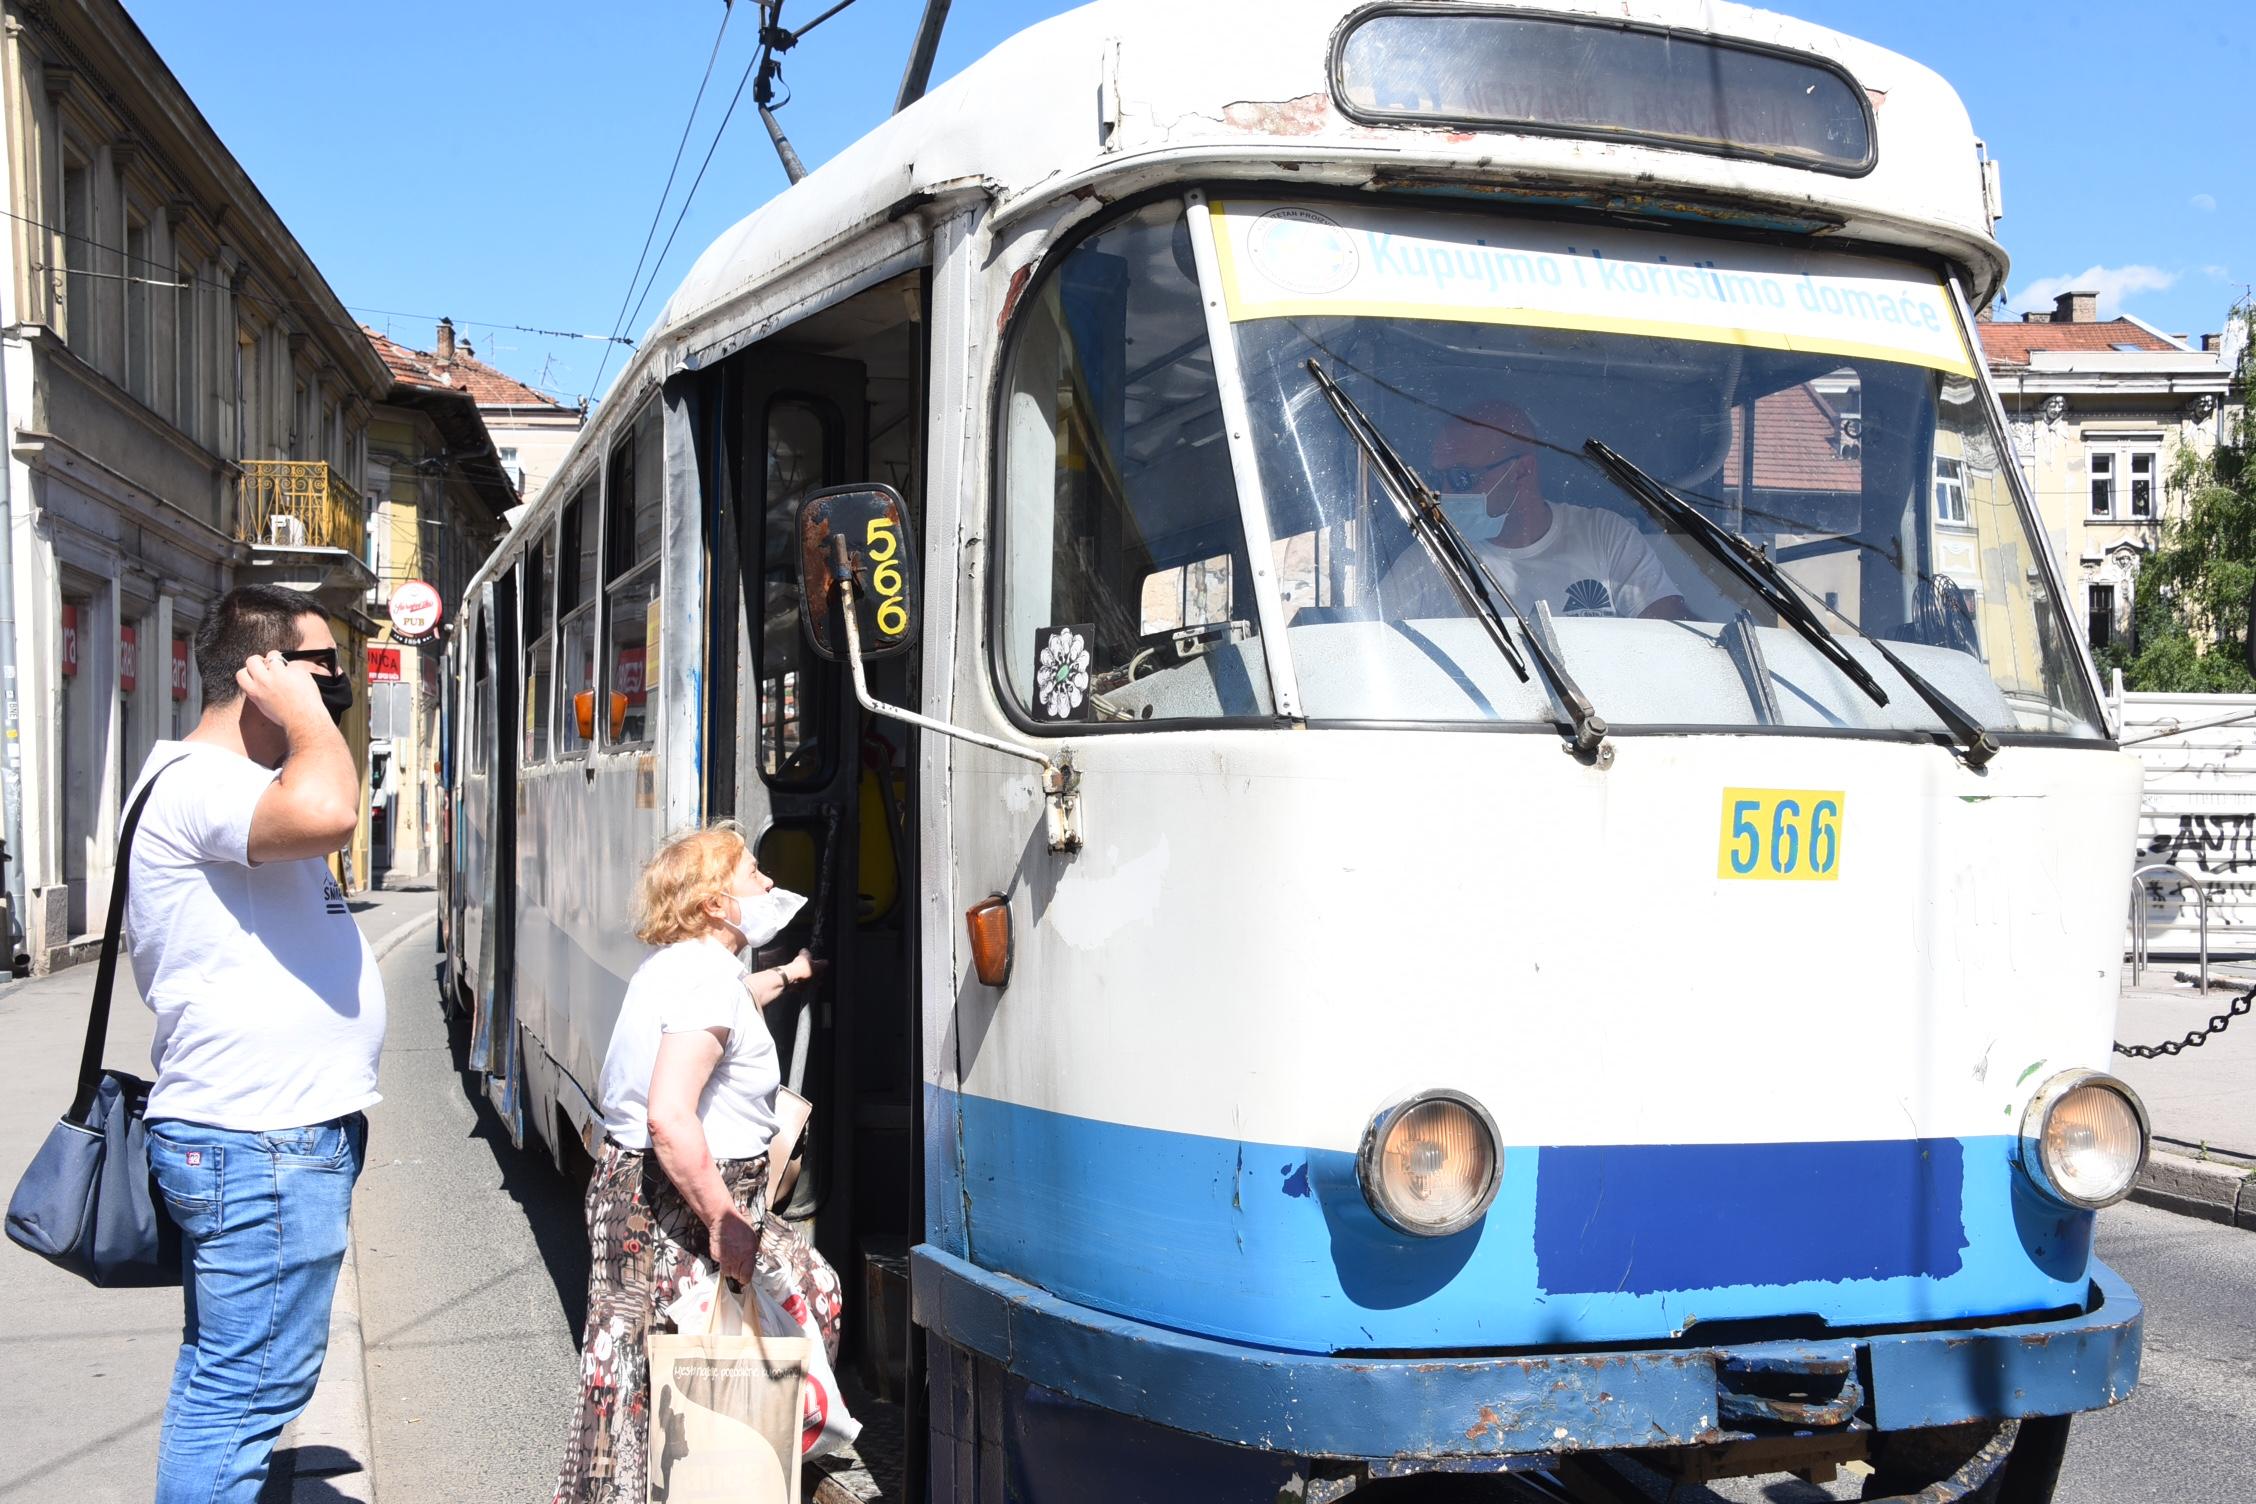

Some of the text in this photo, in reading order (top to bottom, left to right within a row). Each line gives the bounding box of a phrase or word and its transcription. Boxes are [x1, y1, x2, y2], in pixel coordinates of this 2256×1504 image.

[1366, 230, 1563, 292] Kupujmo
[1567, 246, 1588, 289] i
[1591, 248, 1787, 309] koristimo
[1795, 271, 1942, 333] domaće
[867, 518, 907, 635] 566
[403, 617, 425, 626] PUB
[1731, 799, 1838, 874] 566
